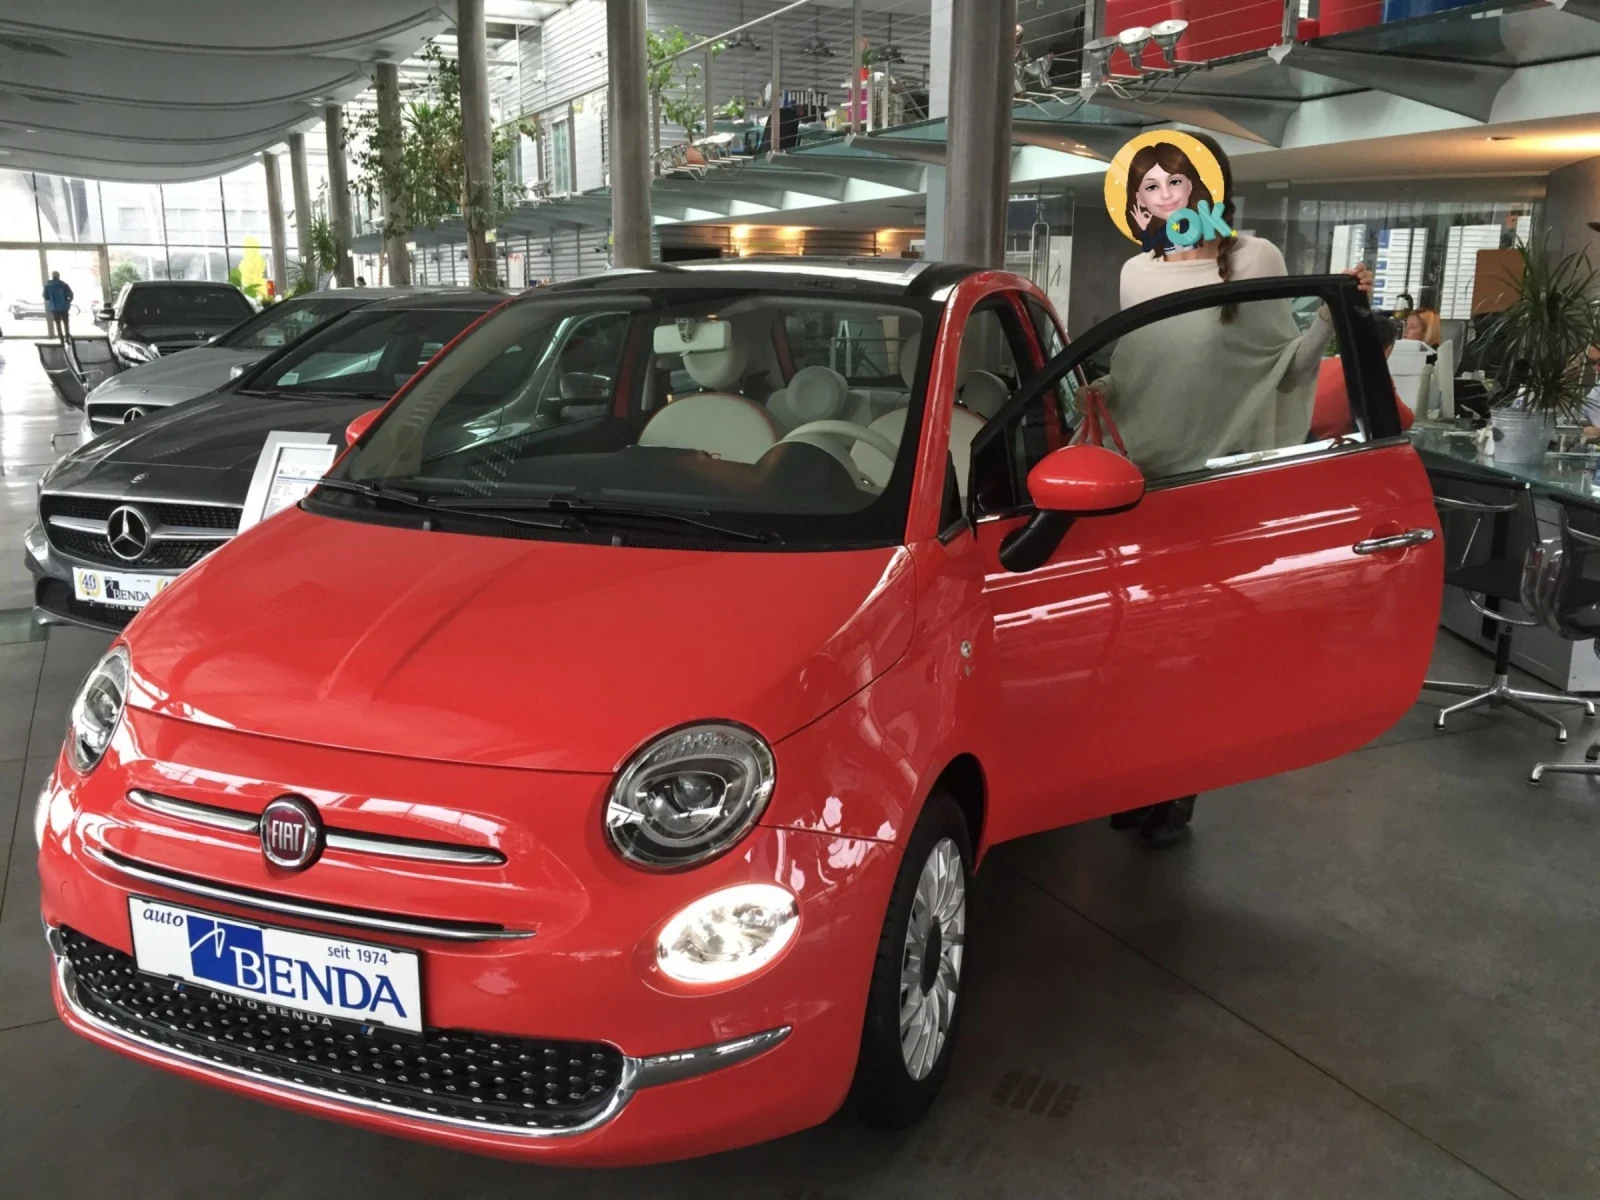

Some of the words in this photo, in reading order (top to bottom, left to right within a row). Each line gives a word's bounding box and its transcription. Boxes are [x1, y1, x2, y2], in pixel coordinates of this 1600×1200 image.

[82, 574, 97, 590] 40
[113, 589, 151, 602] BENDA
[271, 820, 303, 852] FIAT
[143, 908, 184, 927] auto
[327, 945, 351, 960] seit
[356, 949, 389, 966] 1974
[229, 945, 408, 1018] BENDA
[210, 991, 258, 1010] AUTO
[266, 1005, 333, 1027] BENDA
